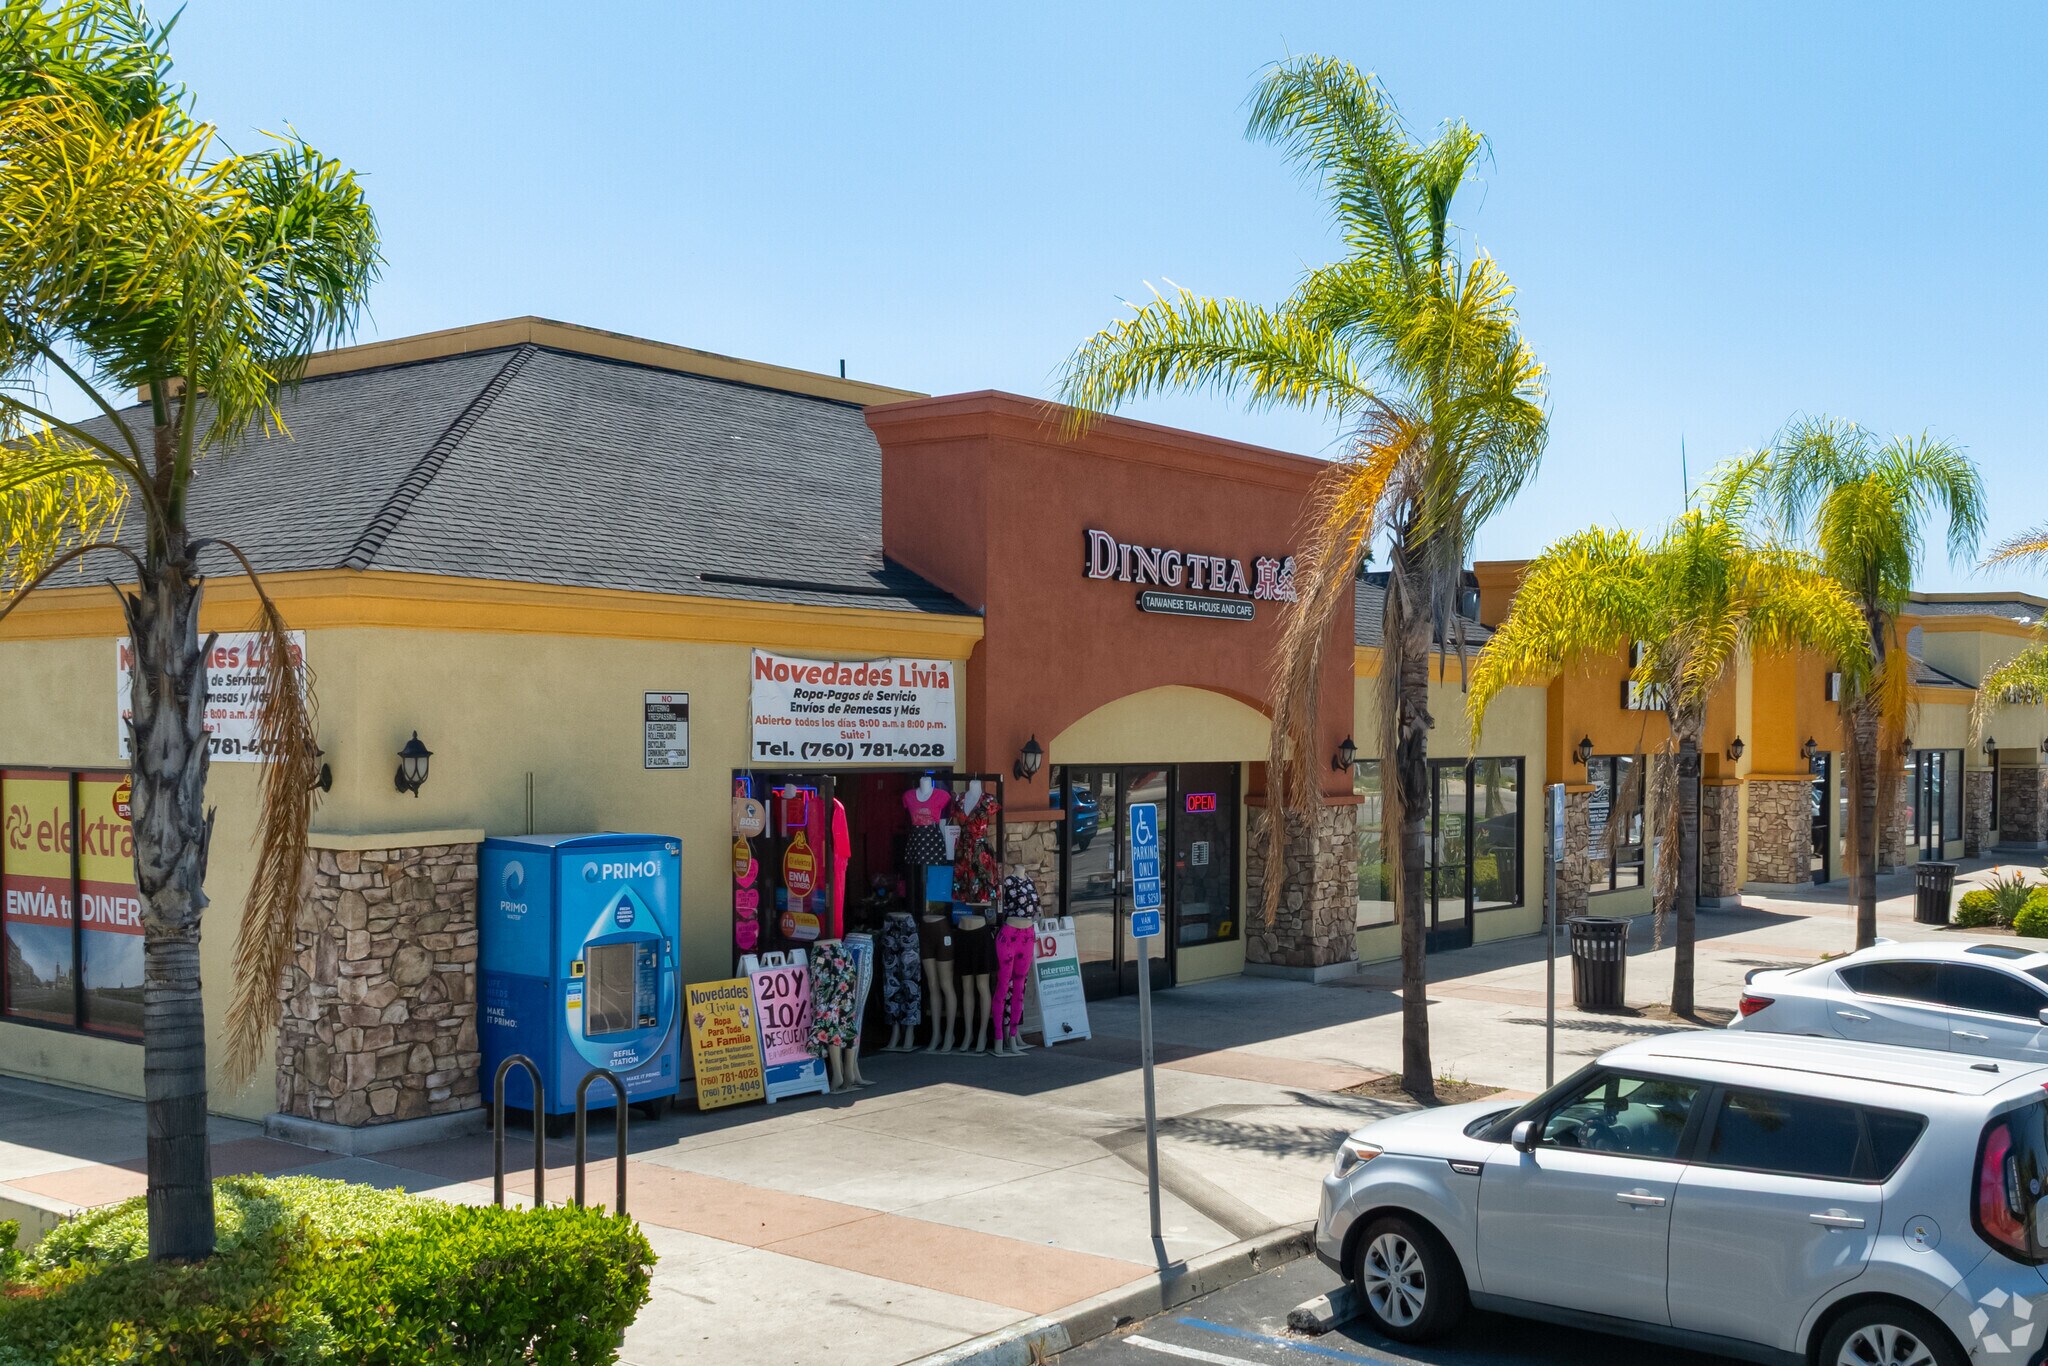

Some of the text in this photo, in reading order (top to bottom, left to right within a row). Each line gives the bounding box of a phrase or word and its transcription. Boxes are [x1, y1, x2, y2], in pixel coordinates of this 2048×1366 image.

[1087, 529, 1250, 595] DING TEA
[1145, 596, 1184, 610] TAIWANESE
[1185, 600, 1198, 611] TEA
[1198, 602, 1220, 613] HOUSE
[1221, 603, 1236, 615] AND
[246, 637, 303, 671] Lia
[211, 673, 224, 687] de
[755, 656, 950, 689] Novedades Livia
[793, 688, 917, 702] Ropa-Pagos de Servicio
[210, 708, 228, 720] 8:00
[229, 709, 248, 720] a.m.
[790, 702, 921, 718] Envíos de Remesas y Más
[755, 715, 792, 726] Abierto
[795, 717, 820, 728] todos
[821, 717, 835, 728] los
[837, 717, 857, 728] días
[859, 719, 880, 728] 8:00
[900, 720, 905, 728] a
[907, 719, 924, 729] 8:00
[927, 720, 947, 731] p.m.
[840, 730, 871, 740] Suite 1
[757, 741, 945, 760] Tel. (760) 781-4028
[1187, 795, 1215, 811] OPEN
[740, 817, 761, 827] BOSS
[37, 806, 134, 858] elektra
[1133, 845, 1158, 861] PARKING
[602, 860, 656, 880] PRIMO
[1138, 861, 1154, 877] ONLY
[6, 885, 58, 919] ENVÍA
[81, 893, 142, 927] DINER
[500, 900, 528, 914] PRIMO
[1040, 964, 1076, 976] intermex
[691, 985, 749, 1006] Novedades
[486, 1006, 505, 1017] MAKE
[705, 1002, 736, 1017] Livia
[764, 1000, 807, 1029] 10%
[486, 1016, 493, 1024] IT
[713, 1017, 732, 1027] Ropa
[707, 1025, 742, 1037] Para Toda
[765, 1025, 811, 1049] DESCUENT
[700, 1033, 751, 1049] La Familia
[613, 1048, 636, 1058] REFILL
[609, 1056, 639, 1067] STATION
[700, 1067, 759, 1086] (760) 781-4028
[702, 1079, 761, 1099] (760) 781-4049
